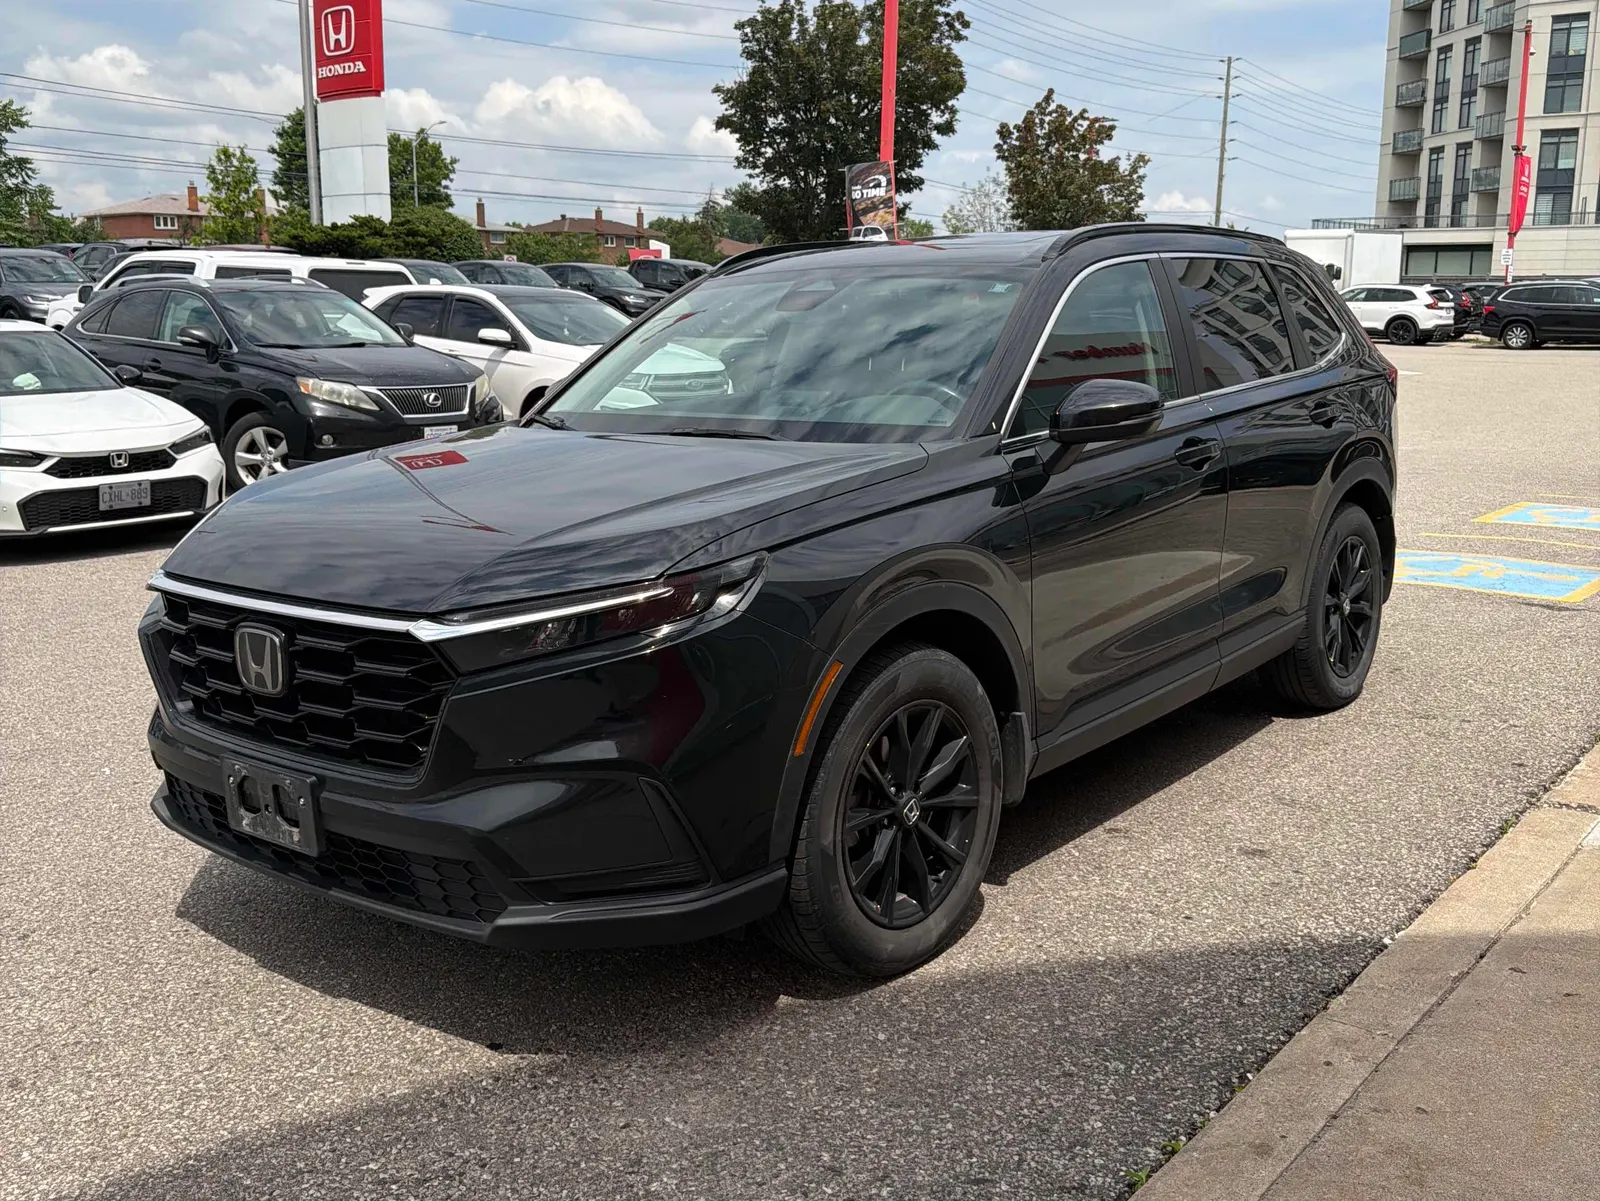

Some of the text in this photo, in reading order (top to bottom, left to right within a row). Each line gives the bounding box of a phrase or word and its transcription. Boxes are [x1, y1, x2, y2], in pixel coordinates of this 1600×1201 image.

[317, 61, 366, 78] HONDA
[862, 187, 886, 198] TIME
[101, 487, 148, 504] CXHL 889
